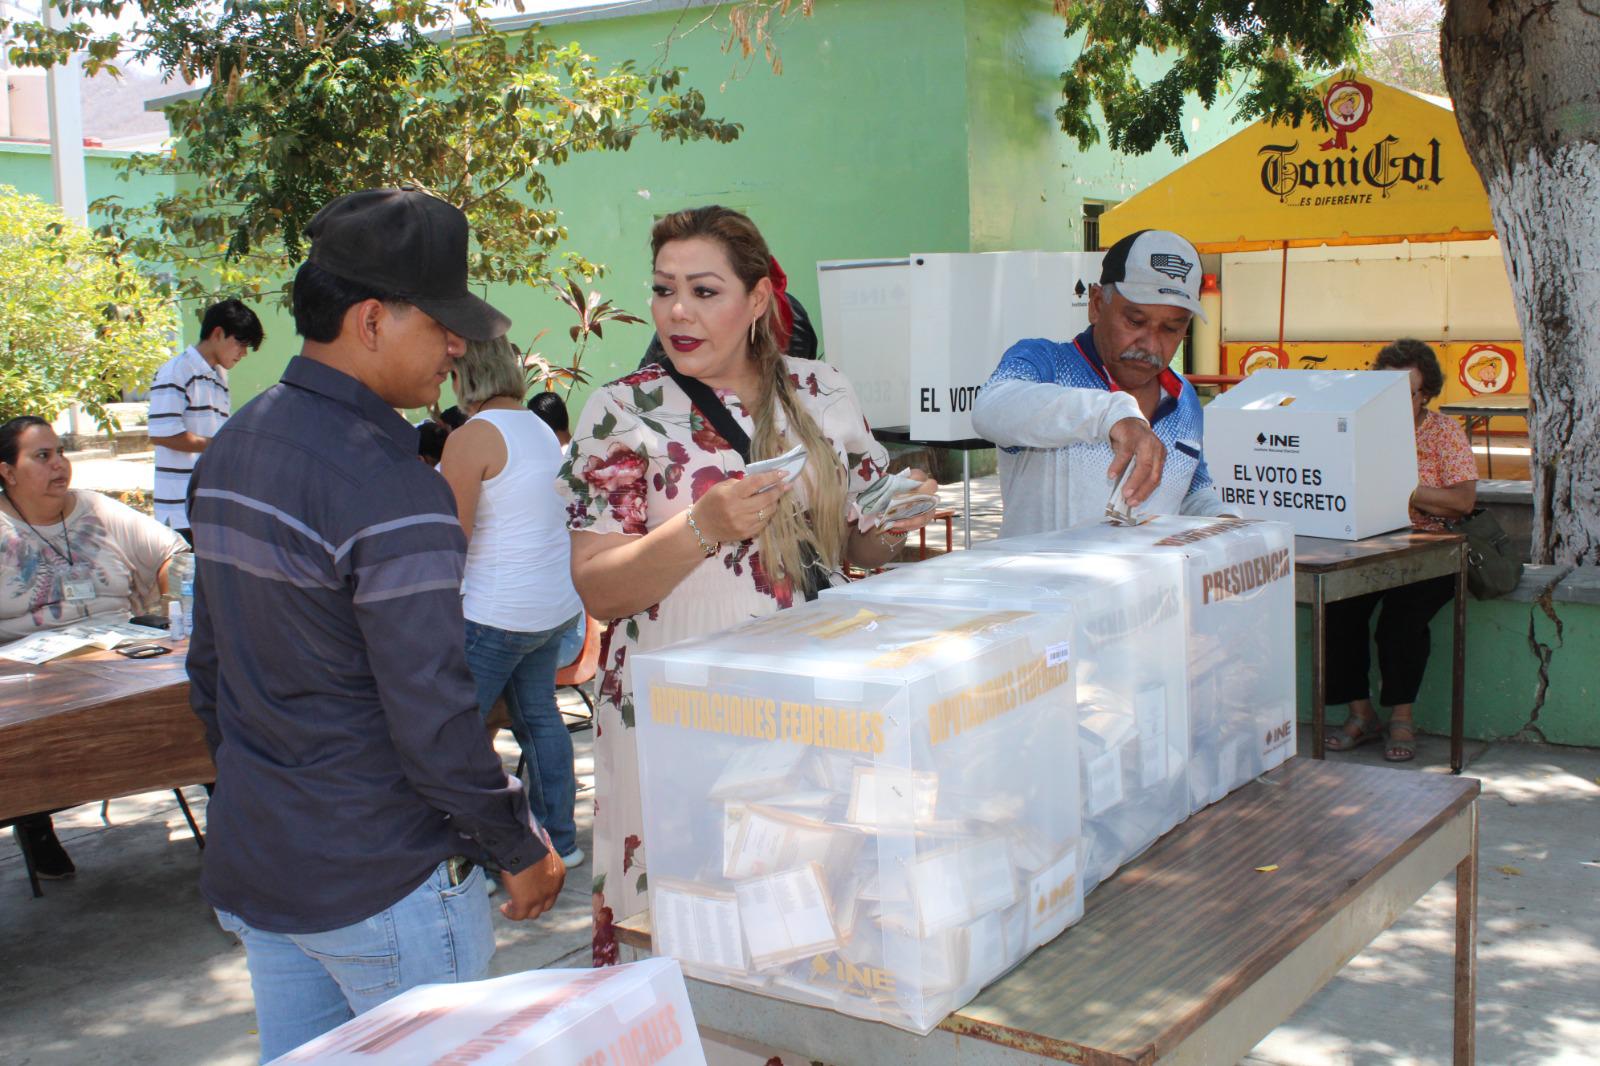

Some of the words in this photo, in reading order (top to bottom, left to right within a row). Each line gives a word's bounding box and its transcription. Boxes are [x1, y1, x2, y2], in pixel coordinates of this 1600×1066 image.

[1257, 134, 1444, 203] ToniCol
[1315, 194, 1372, 206] DIFERENTE
[920, 387, 941, 413] EL
[1270, 434, 1300, 448] INE
[1234, 464, 1252, 481] EL
[1255, 465, 1298, 484] VOTO
[1302, 468, 1322, 486] ES
[1212, 486, 1256, 504] IBRE
[1259, 489, 1269, 506] Y
[1273, 490, 1347, 512] SECRETO
[1202, 547, 1291, 605] PRESIDENCIA
[650, 685, 777, 741] DIPUTACIONES
[780, 700, 885, 754] FEDERALES
[1273, 720, 1291, 742] INE
[836, 957, 897, 993] INE
